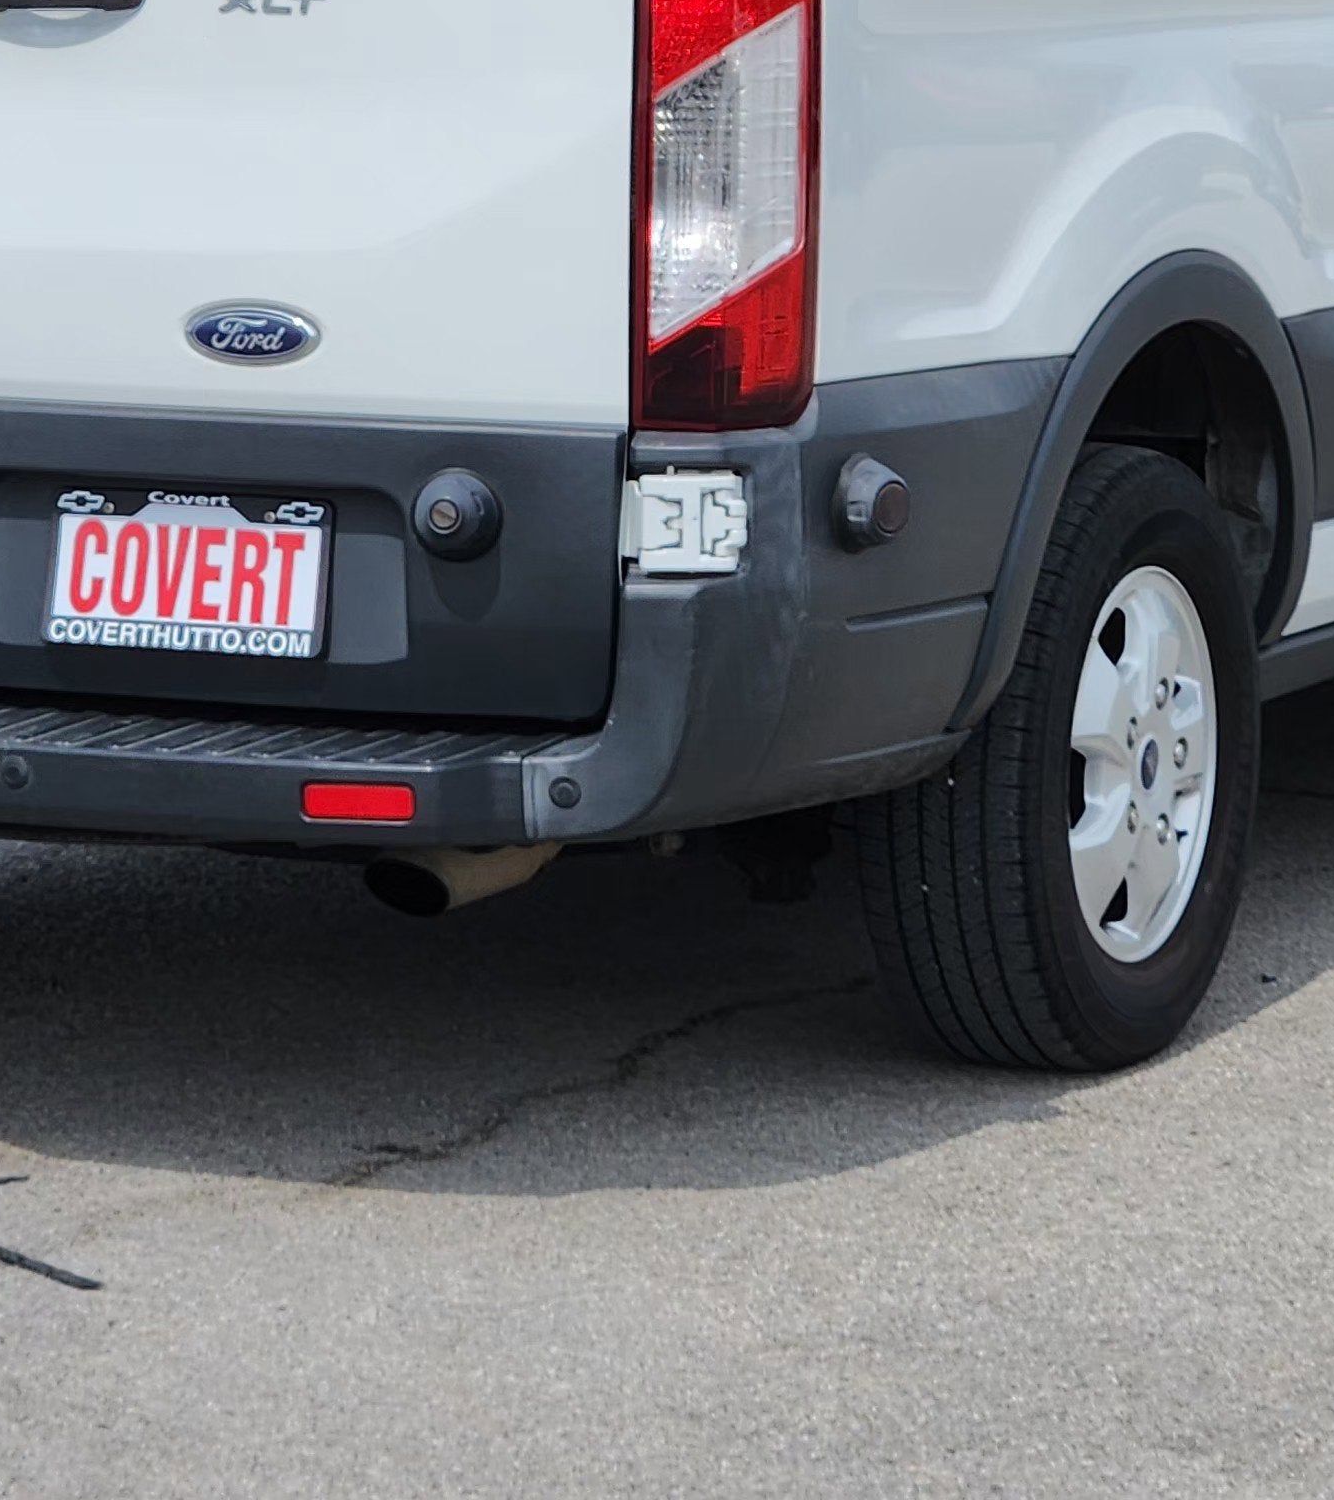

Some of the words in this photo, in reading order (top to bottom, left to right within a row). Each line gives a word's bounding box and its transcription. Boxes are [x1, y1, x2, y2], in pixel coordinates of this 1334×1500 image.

[210, 316, 287, 351] Ford
[147, 490, 231, 507] Covert
[69, 517, 306, 626] COVERT
[48, 617, 313, 658] COVERTHUTTO.COM
